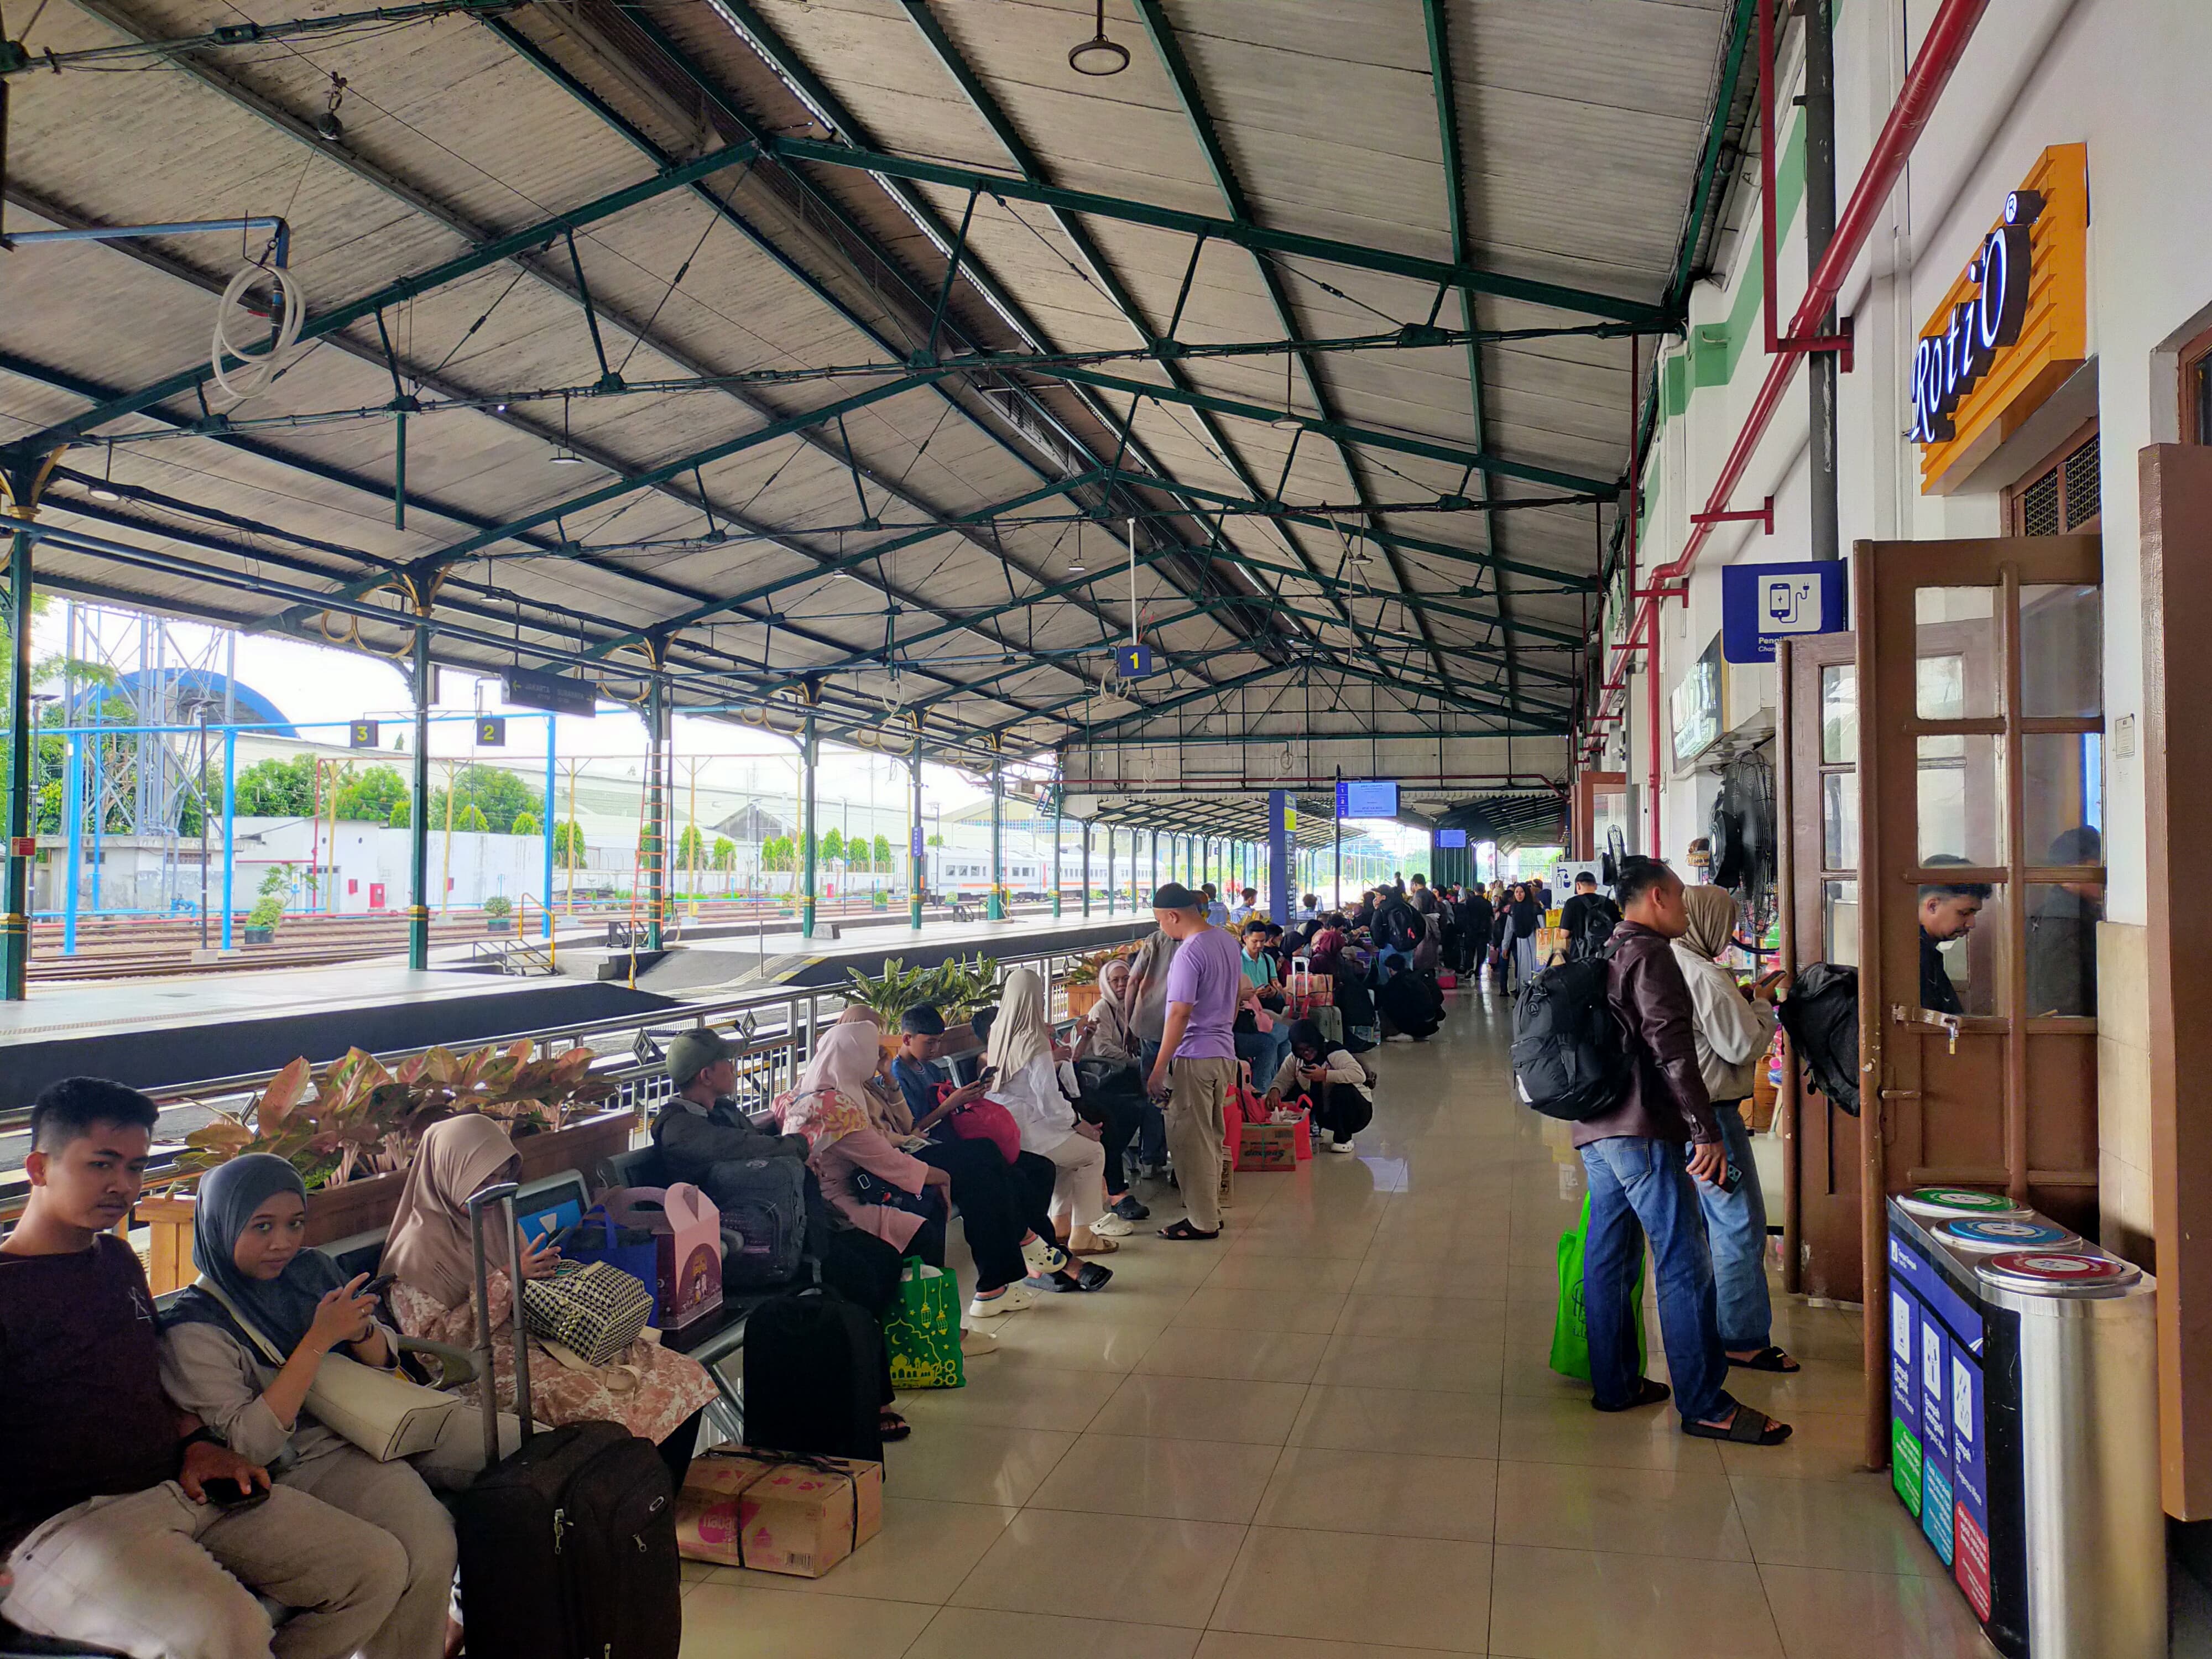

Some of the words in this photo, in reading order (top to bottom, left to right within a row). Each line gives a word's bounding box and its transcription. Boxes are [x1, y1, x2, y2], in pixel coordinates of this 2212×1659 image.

[1130, 652, 1139, 669] 1
[357, 726, 368, 742] 3
[483, 724, 494, 740] 2
